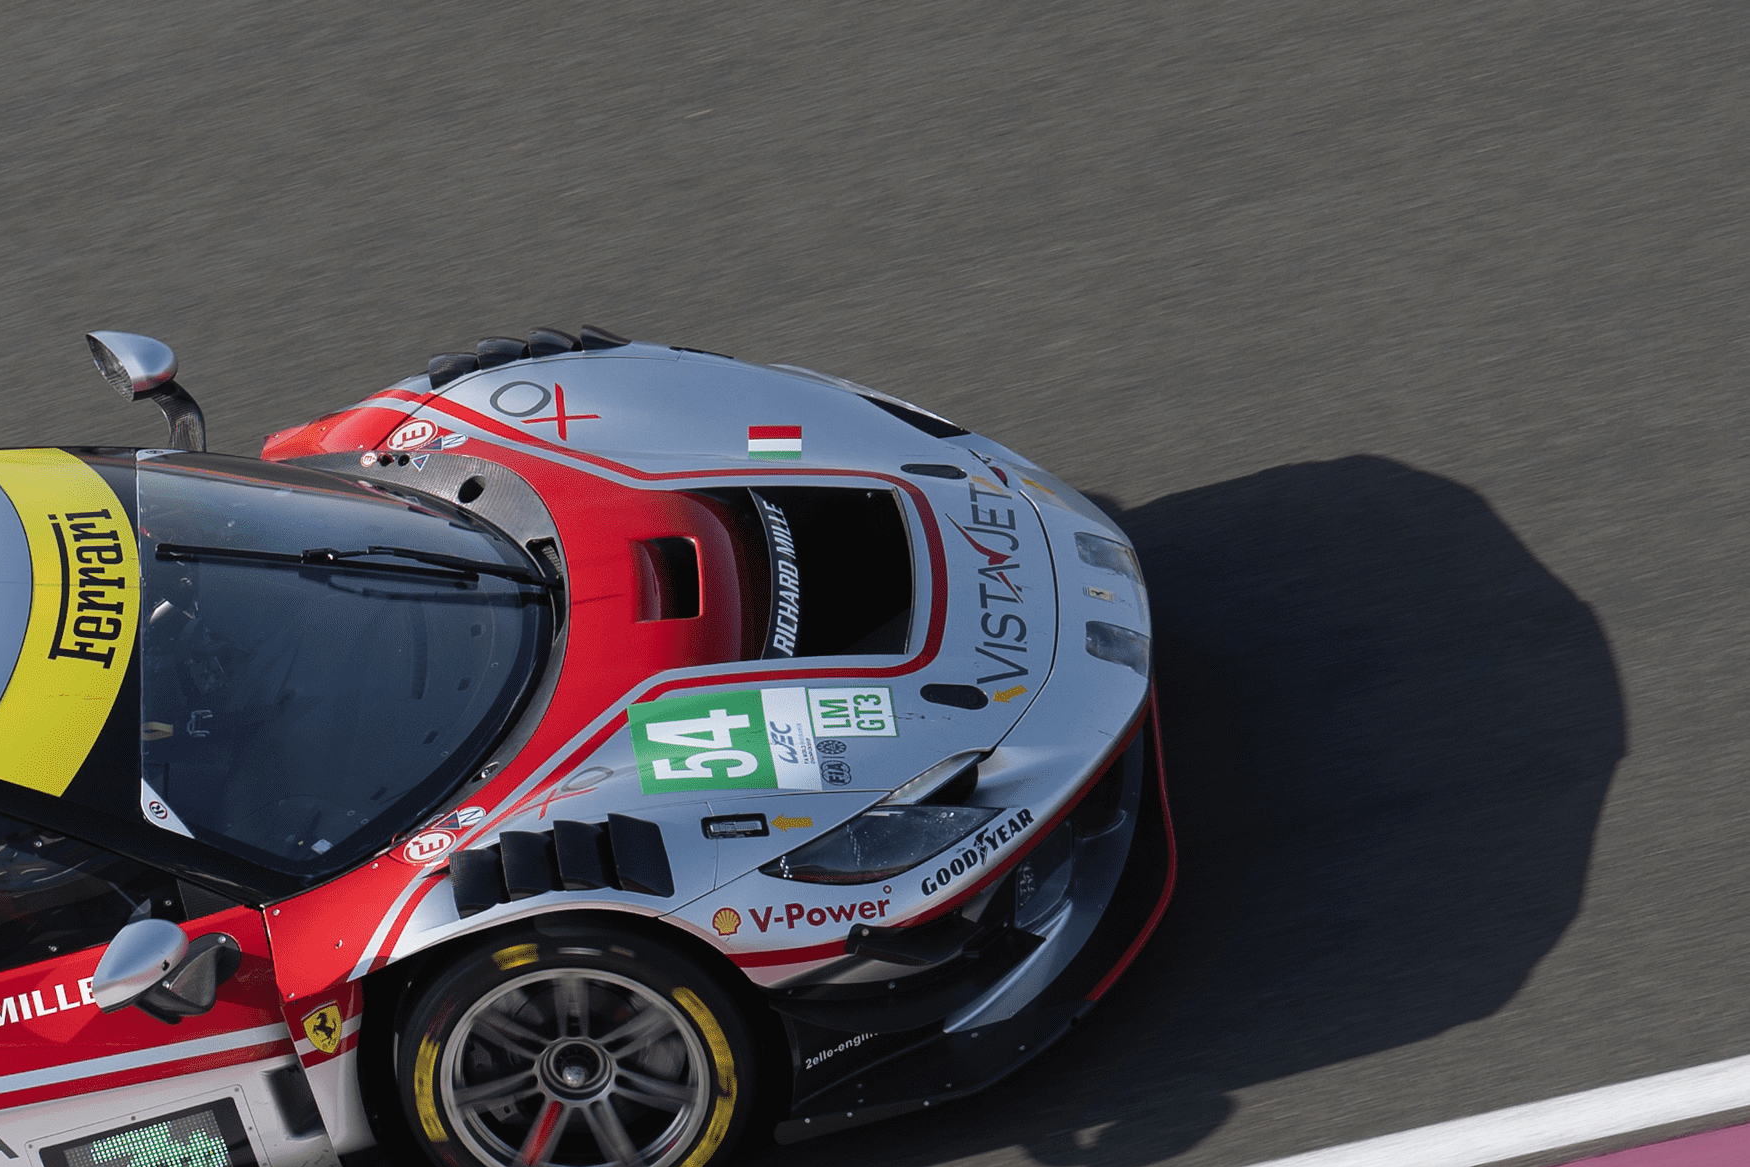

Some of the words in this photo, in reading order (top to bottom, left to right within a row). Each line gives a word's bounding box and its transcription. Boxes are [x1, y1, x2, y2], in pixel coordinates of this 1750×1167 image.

[762, 500, 797, 560] MILLE
[47, 508, 124, 670] Ferrari
[773, 559, 800, 657] RICHARD
[819, 699, 851, 729] LM
[853, 693, 886, 731] GT3
[645, 708, 758, 780] 54
[769, 720, 799, 764] WEC
[748, 899, 891, 933] V-Power
